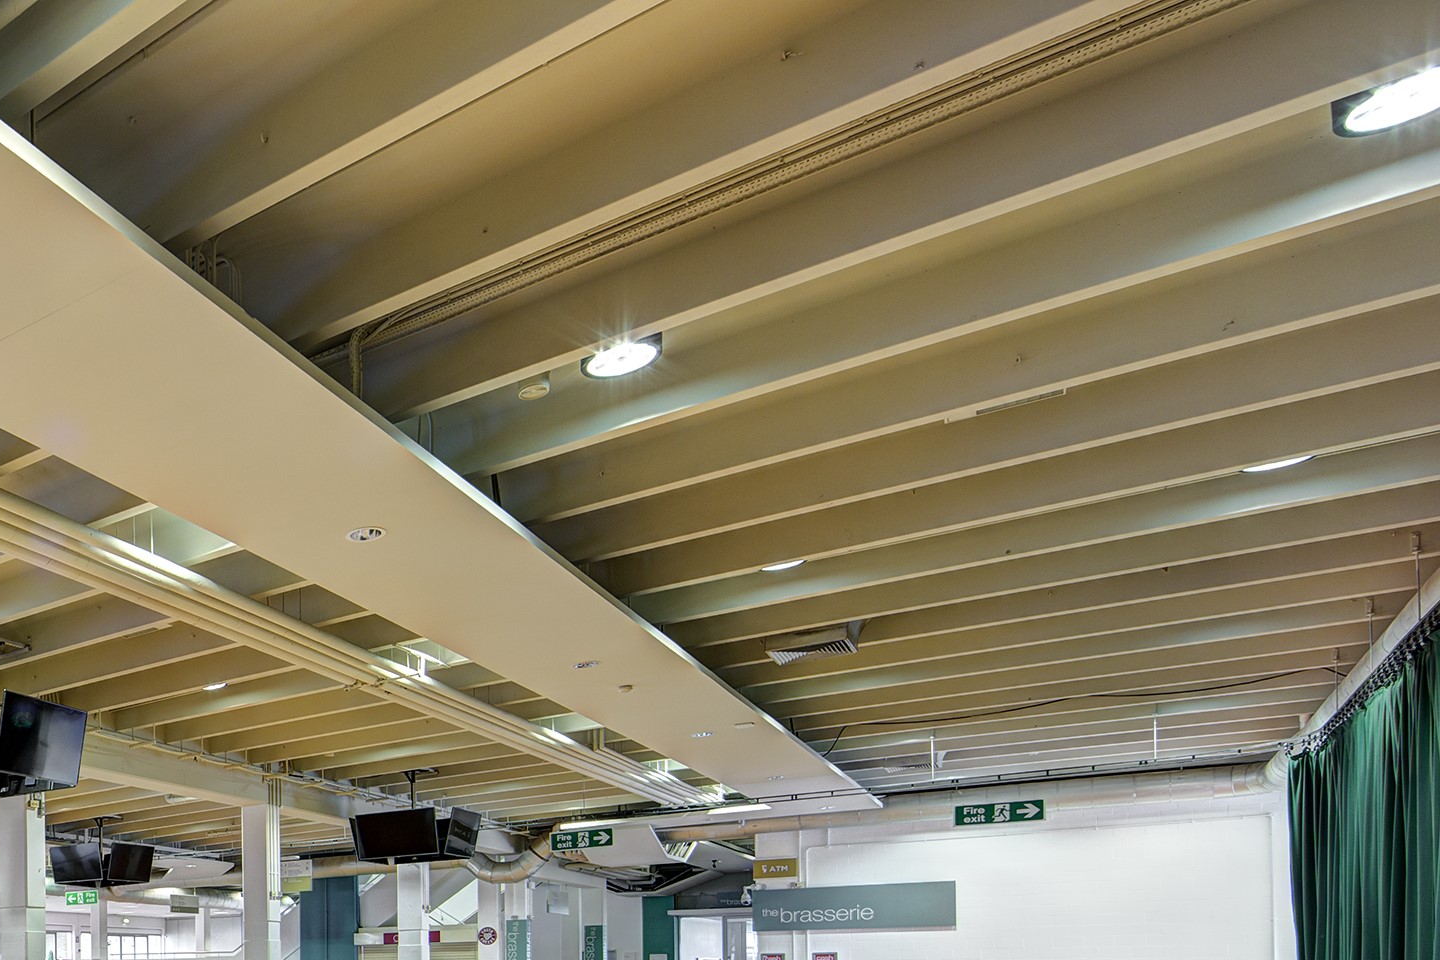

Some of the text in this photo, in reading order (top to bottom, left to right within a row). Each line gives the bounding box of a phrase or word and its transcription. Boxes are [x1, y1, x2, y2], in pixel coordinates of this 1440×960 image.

[963, 806, 986, 815] Fire
[963, 814, 986, 824] exit
[556, 834, 572, 842] Fire
[556, 841, 572, 849] exit
[769, 865, 789, 873] ATM
[762, 904, 875, 923] the brasserie
